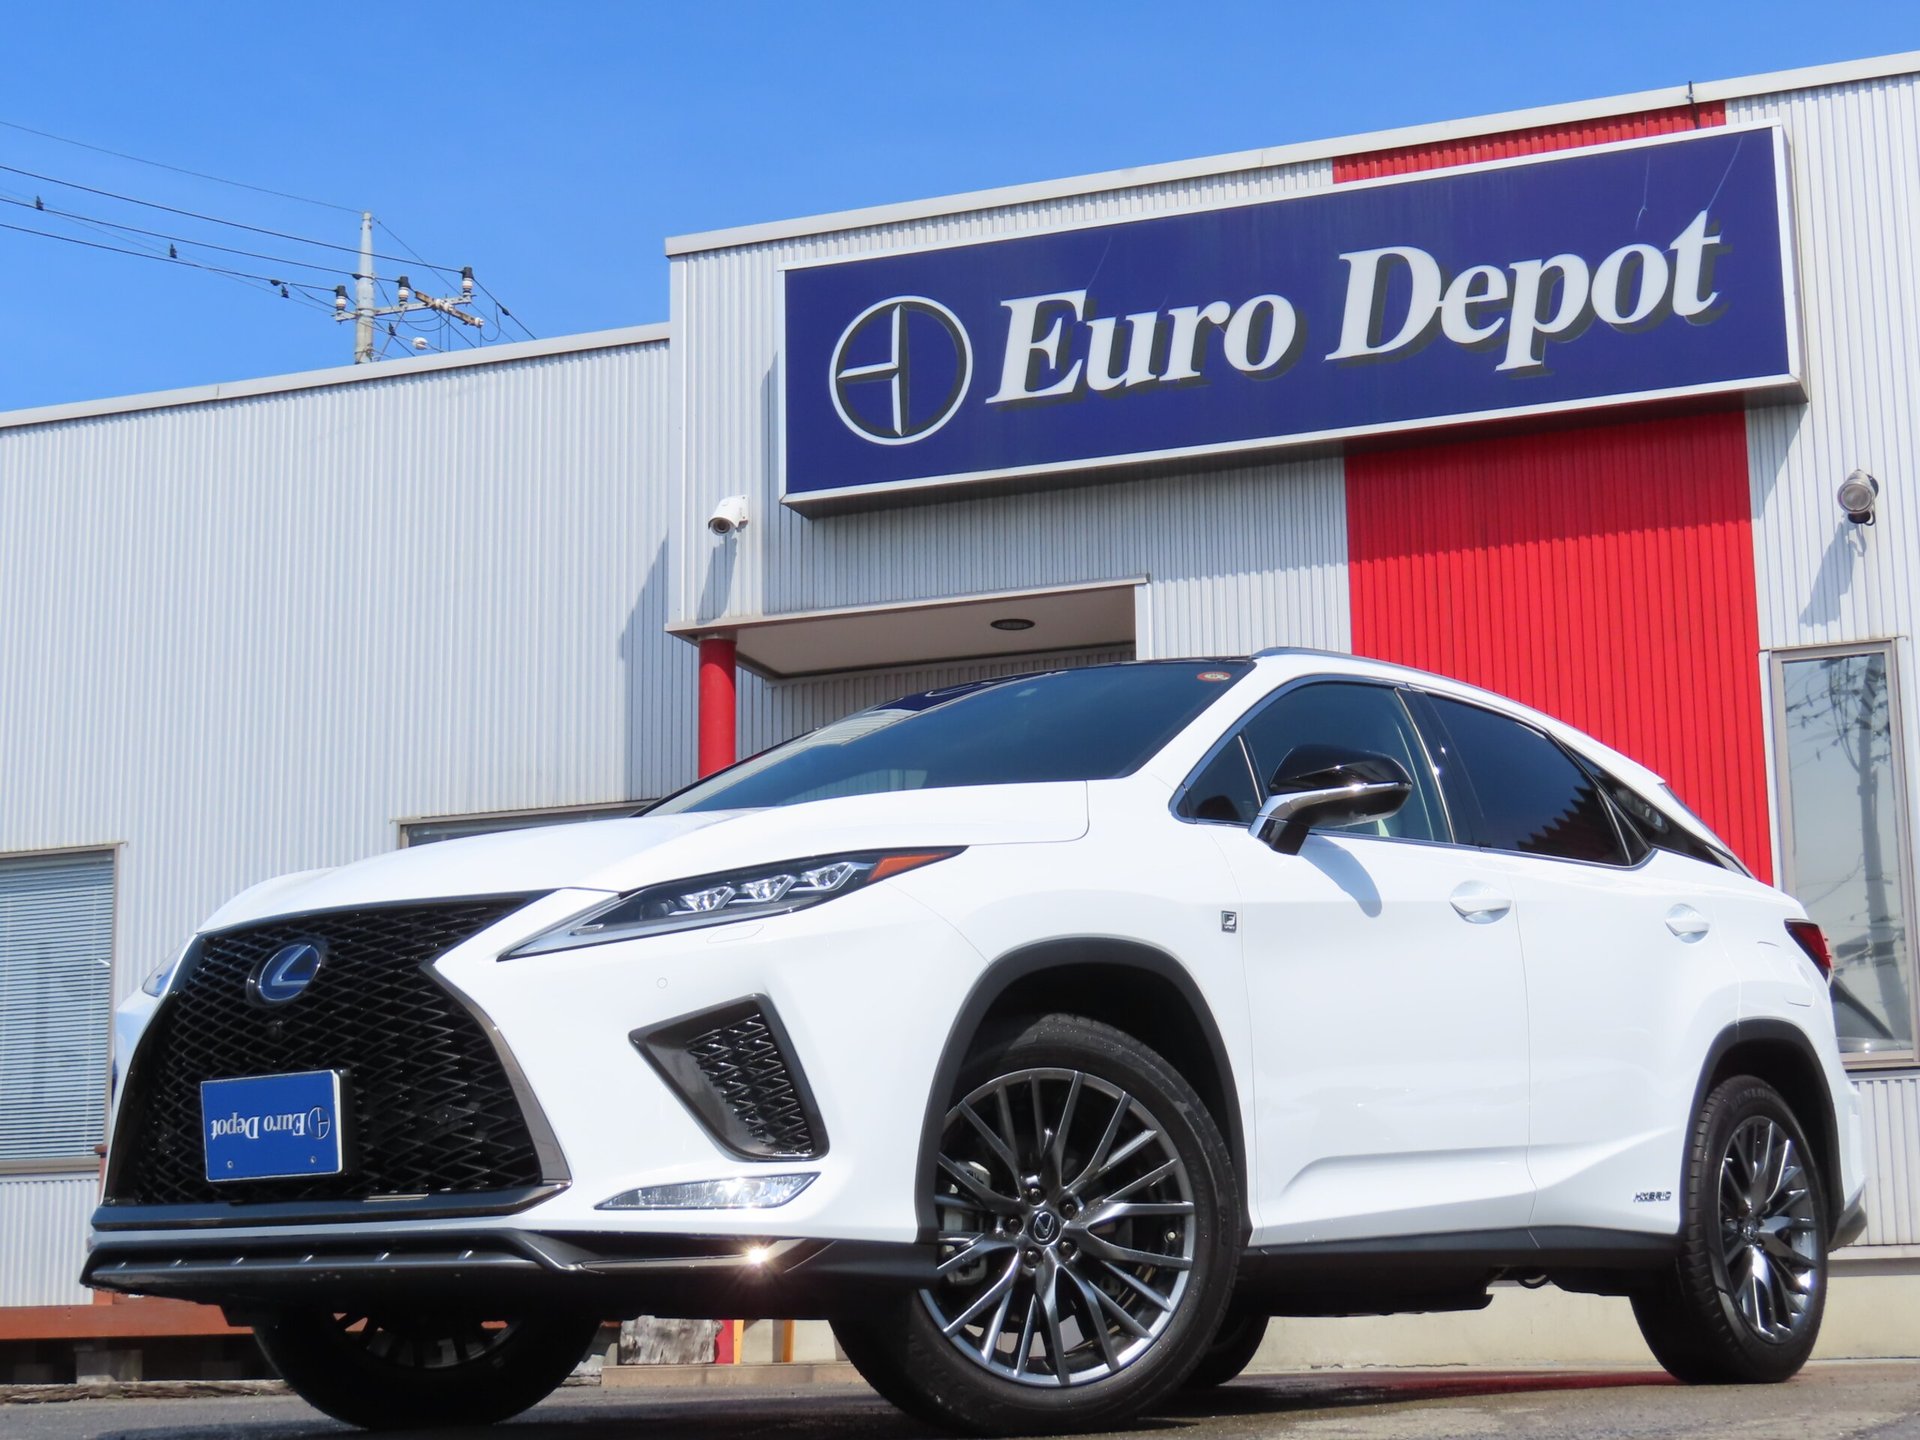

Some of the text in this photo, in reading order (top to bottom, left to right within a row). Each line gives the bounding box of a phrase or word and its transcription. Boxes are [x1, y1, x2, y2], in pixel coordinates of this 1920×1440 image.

[985, 210, 1721, 403] Euro Depot
[211, 1112, 306, 1140] Euro Depot
